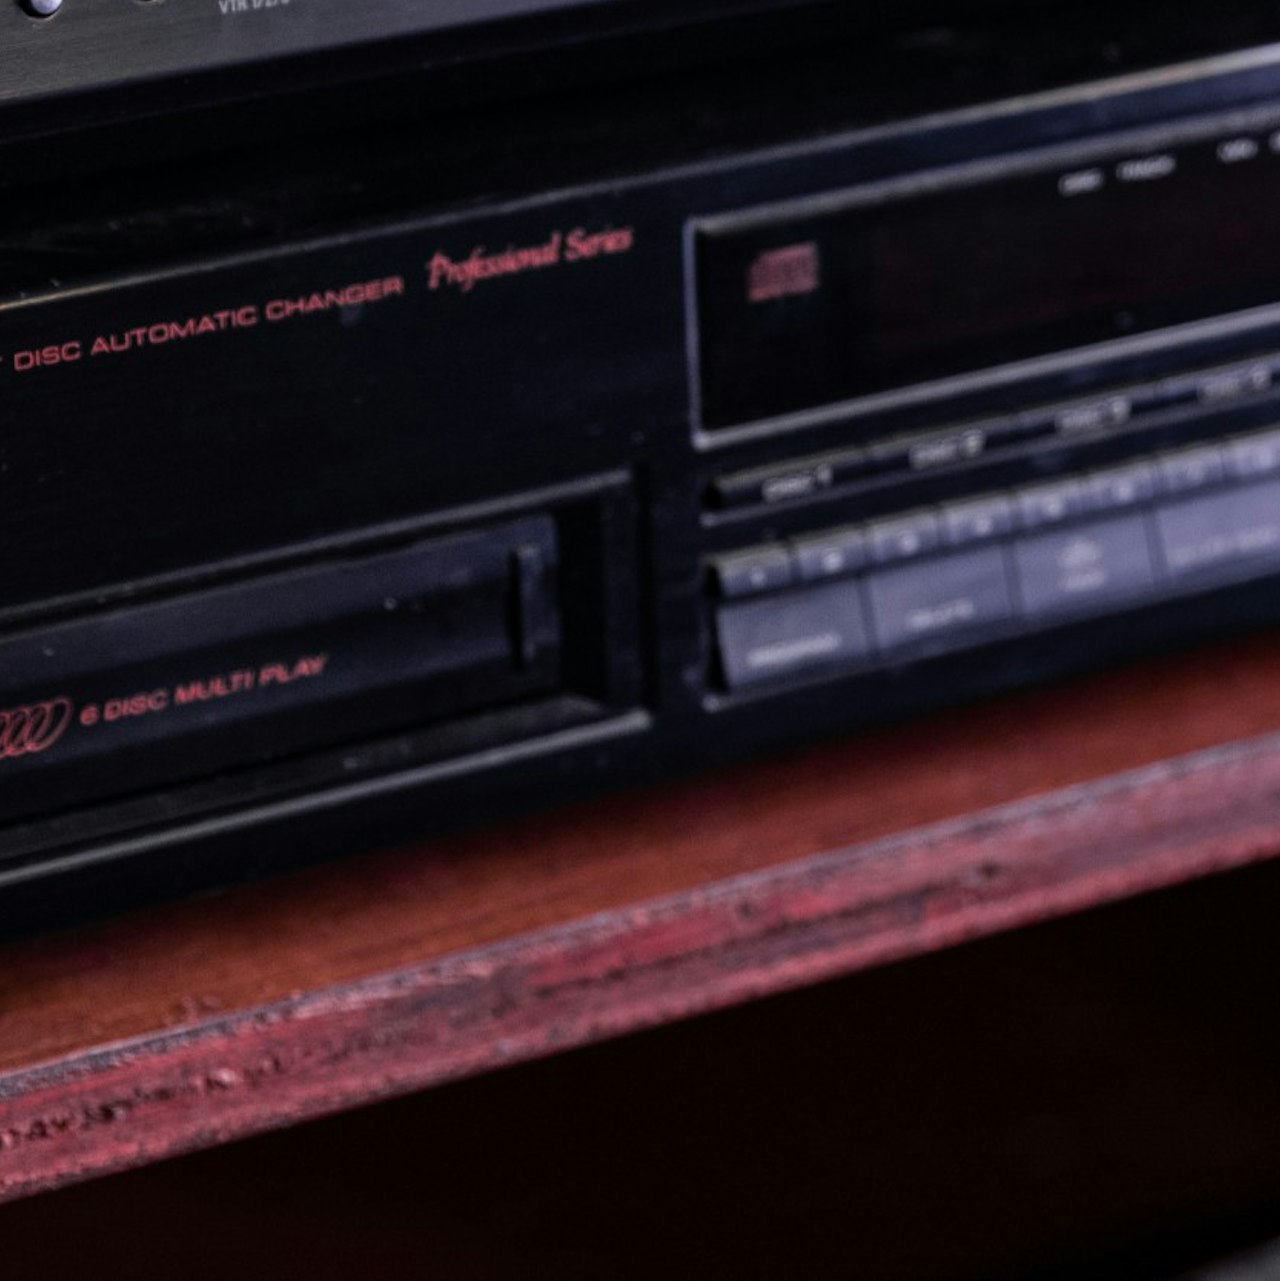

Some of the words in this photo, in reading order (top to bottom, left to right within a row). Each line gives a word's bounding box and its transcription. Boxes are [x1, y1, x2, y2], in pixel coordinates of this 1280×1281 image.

[425, 230, 562, 292] Professional
[564, 224, 634, 262] Series
[14, 340, 82, 372] DISC
[90, 304, 258, 356] AUTOMATIC
[264, 275, 405, 321] CHANGER
[79, 704, 99, 726] 6
[104, 691, 169, 722] DISC
[175, 671, 256, 706] MULTI
[262, 653, 329, 687] PLAY
